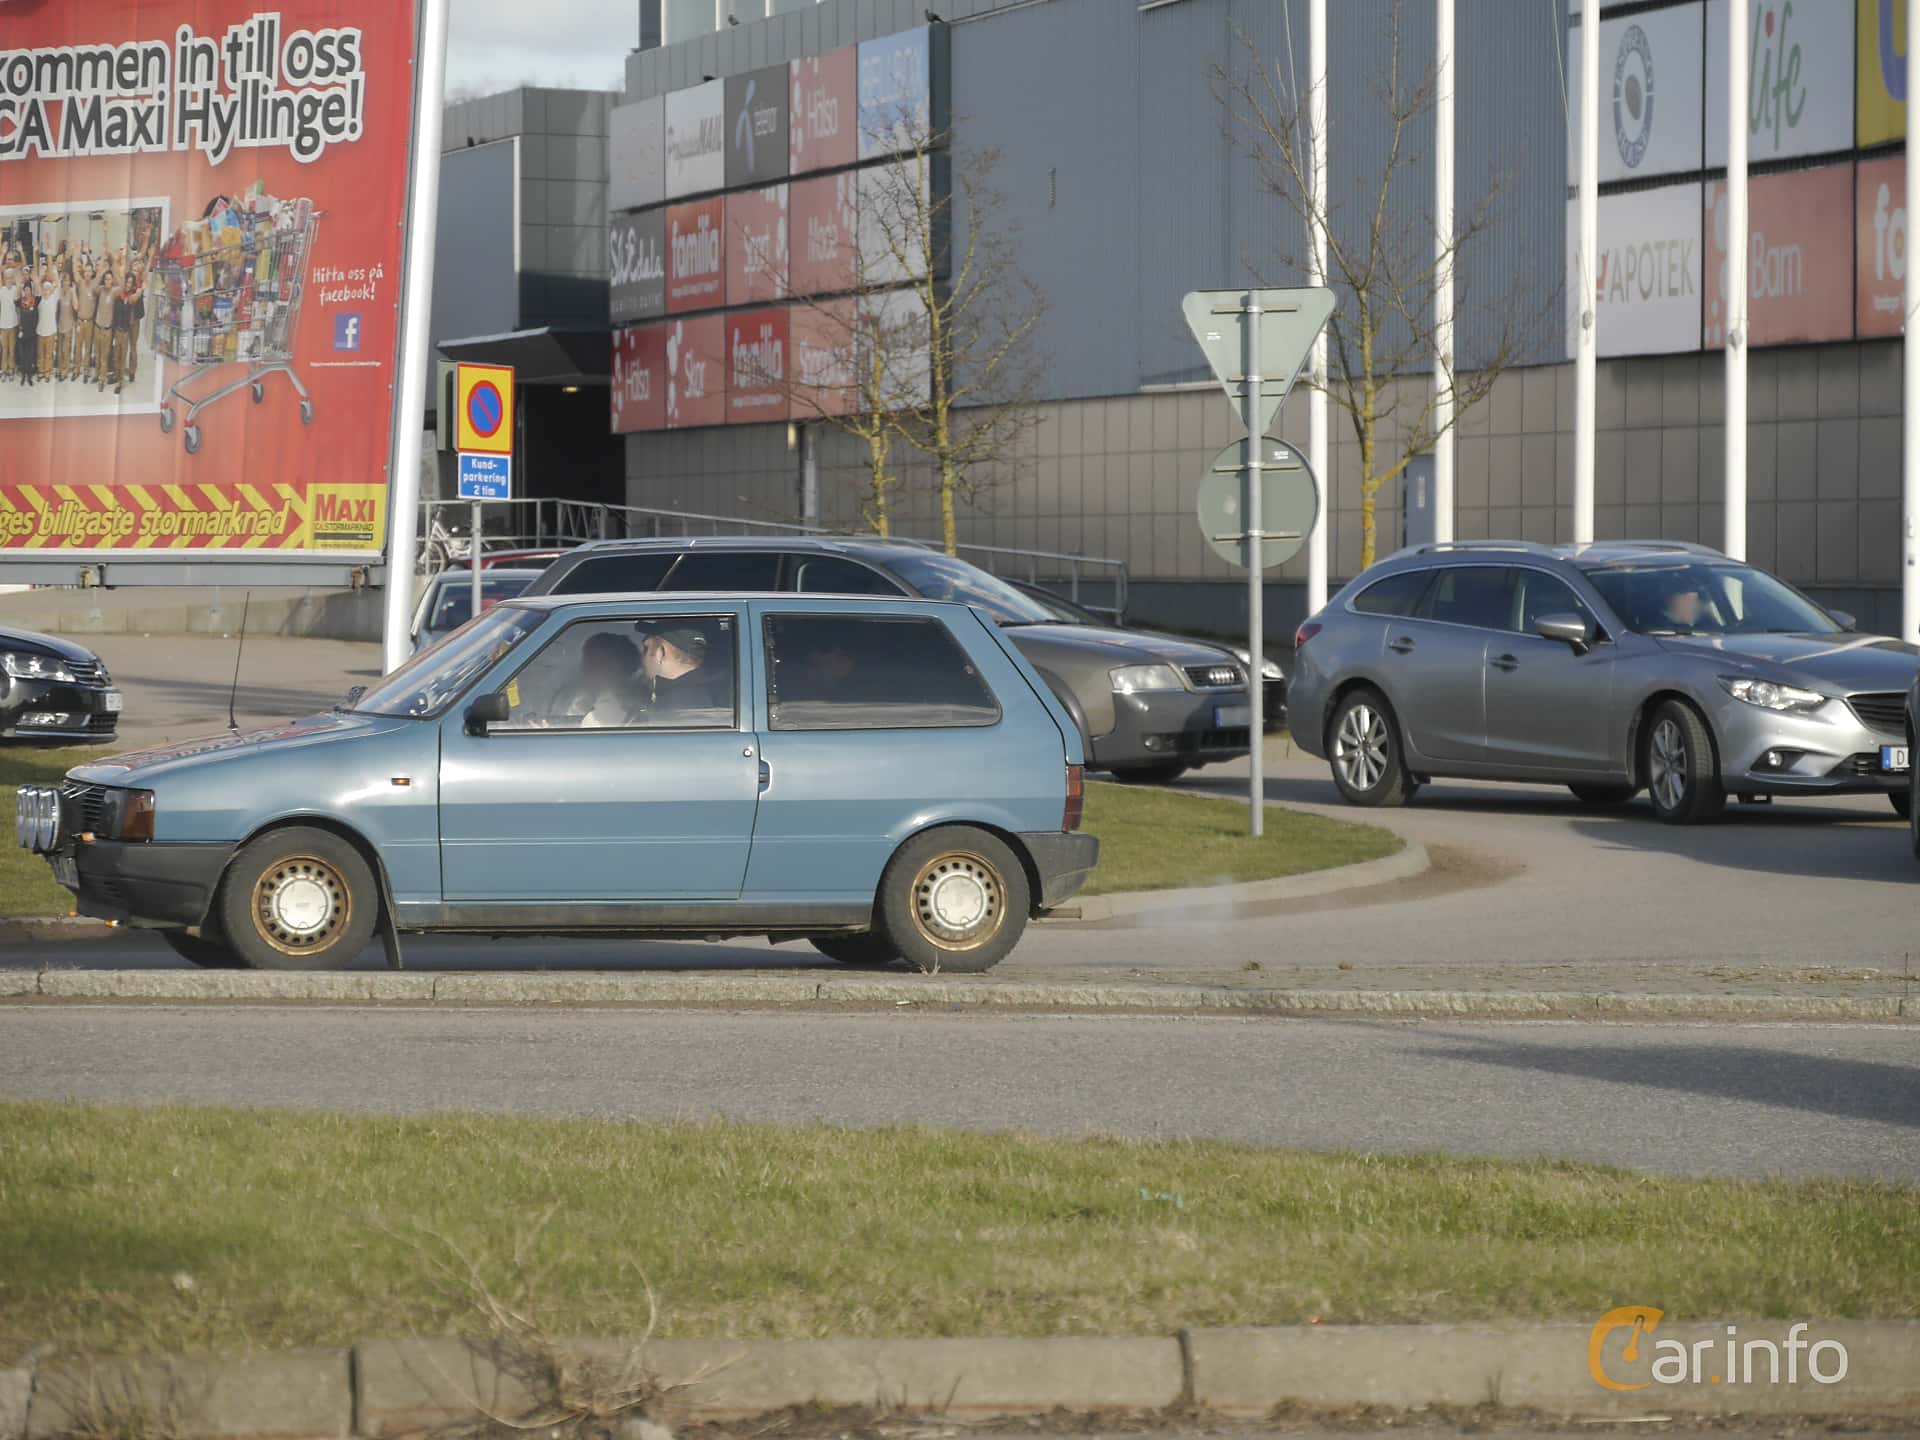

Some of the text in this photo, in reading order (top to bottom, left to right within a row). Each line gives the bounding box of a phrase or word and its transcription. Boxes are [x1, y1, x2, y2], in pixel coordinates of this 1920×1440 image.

[179, 29, 215, 87] in
[225, 17, 276, 84] till
[285, 32, 358, 81] oss
[62, 90, 165, 150] Maxi
[178, 77, 361, 158] Hyllinge!
[312, 262, 384, 284] Hitta oss på
[1608, 238, 1695, 303] APOTEK
[320, 281, 375, 307] facebook!
[471, 458, 498, 470] Kund-
[463, 472, 506, 486] parkering
[473, 485, 496, 497] 2 tim
[314, 493, 376, 522] MAXI
[38, 498, 135, 546] billigaste
[138, 501, 292, 537] stormarknad
